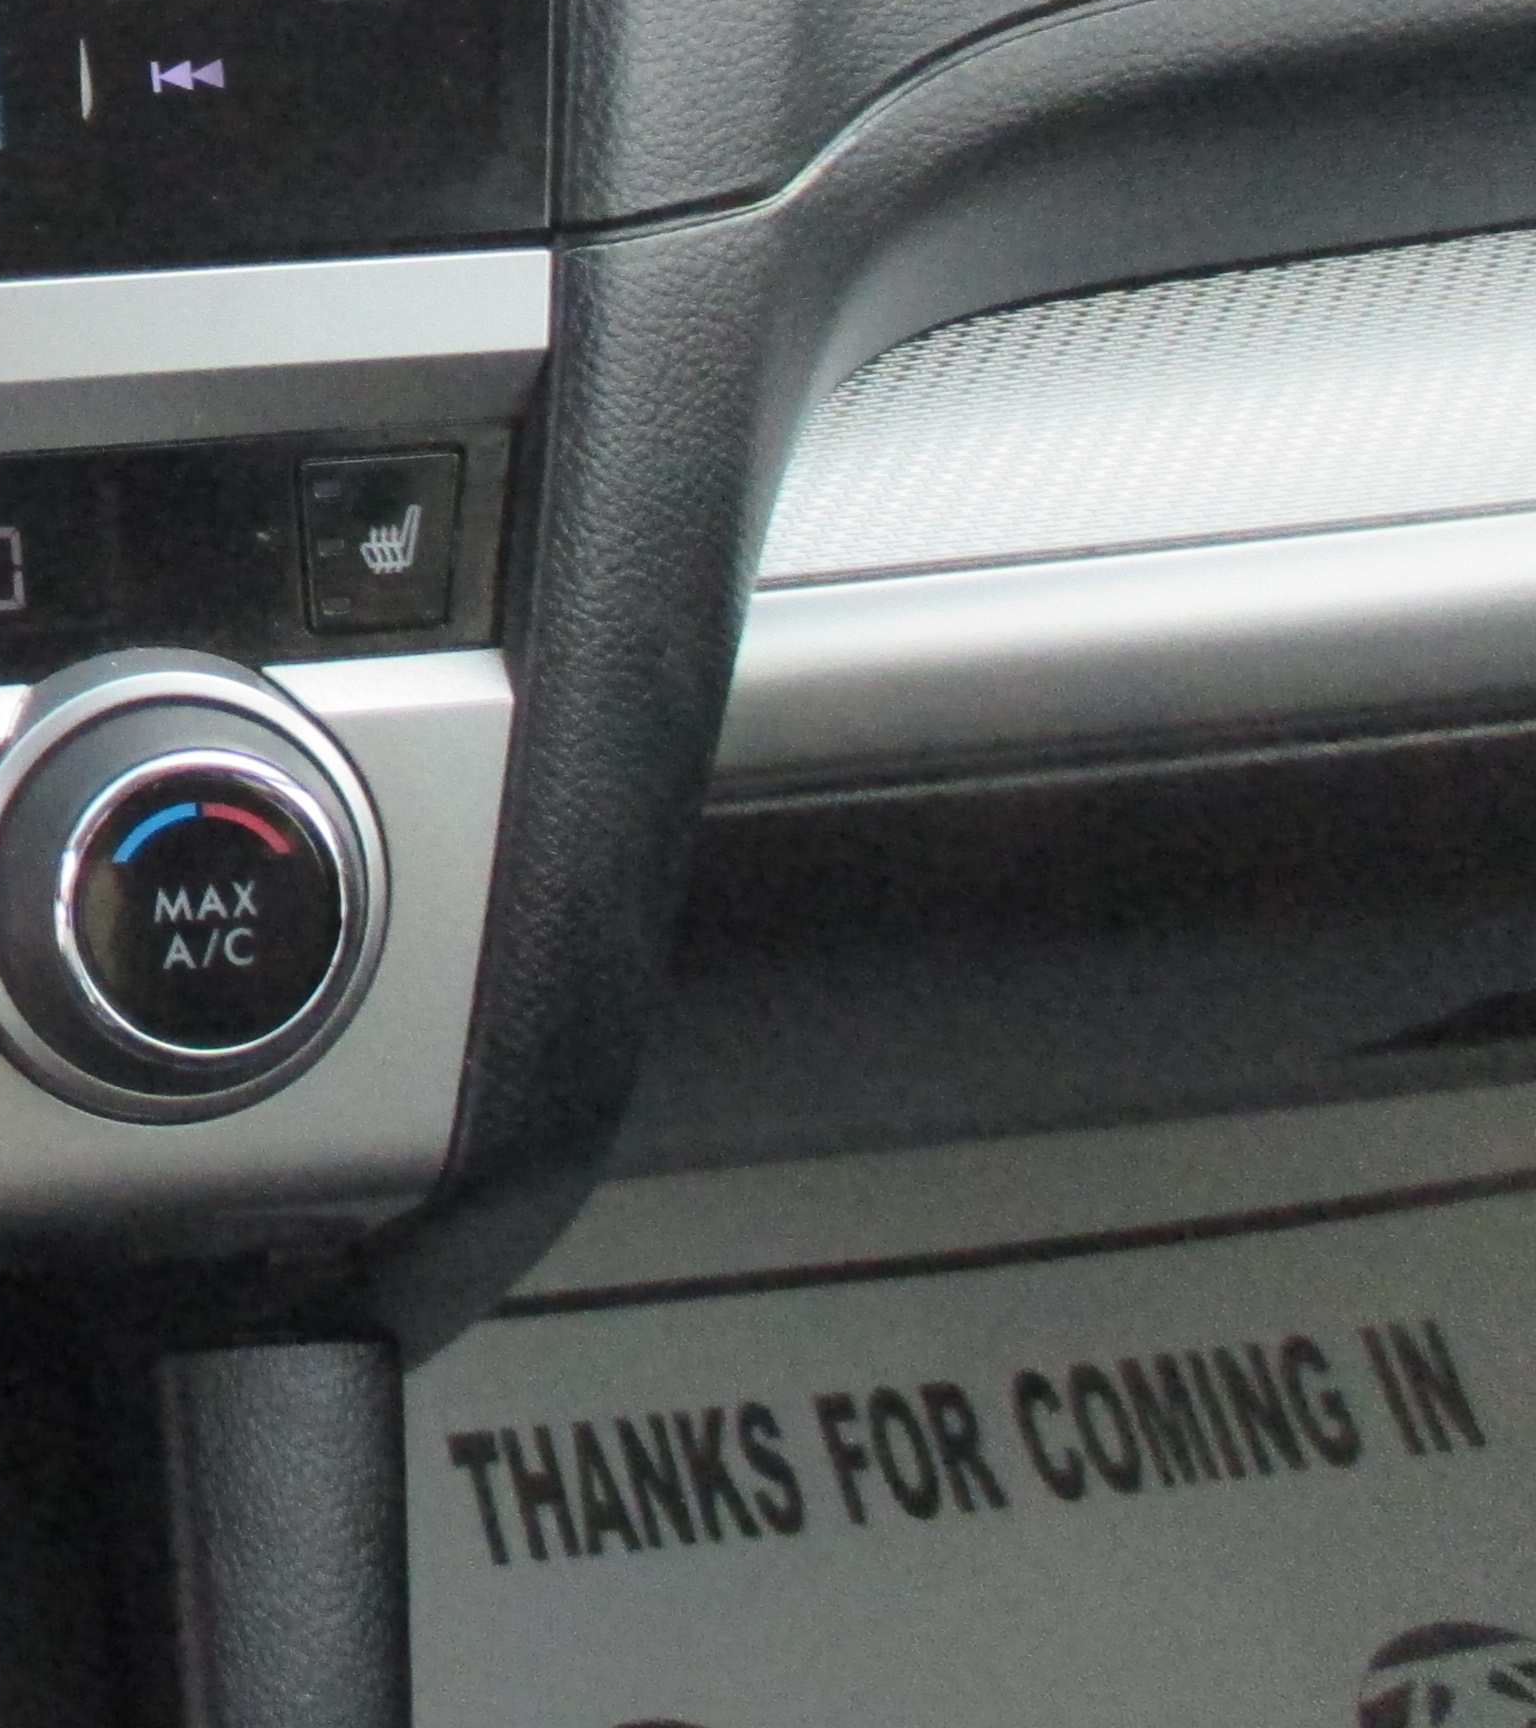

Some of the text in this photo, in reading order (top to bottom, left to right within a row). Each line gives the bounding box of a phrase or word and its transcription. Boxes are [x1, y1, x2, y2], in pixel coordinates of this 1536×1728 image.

[154, 881, 258, 926] MAX
[161, 925, 256, 971] A/C
[447, 1319, 1488, 1566] THANKS FOR COMING IN
